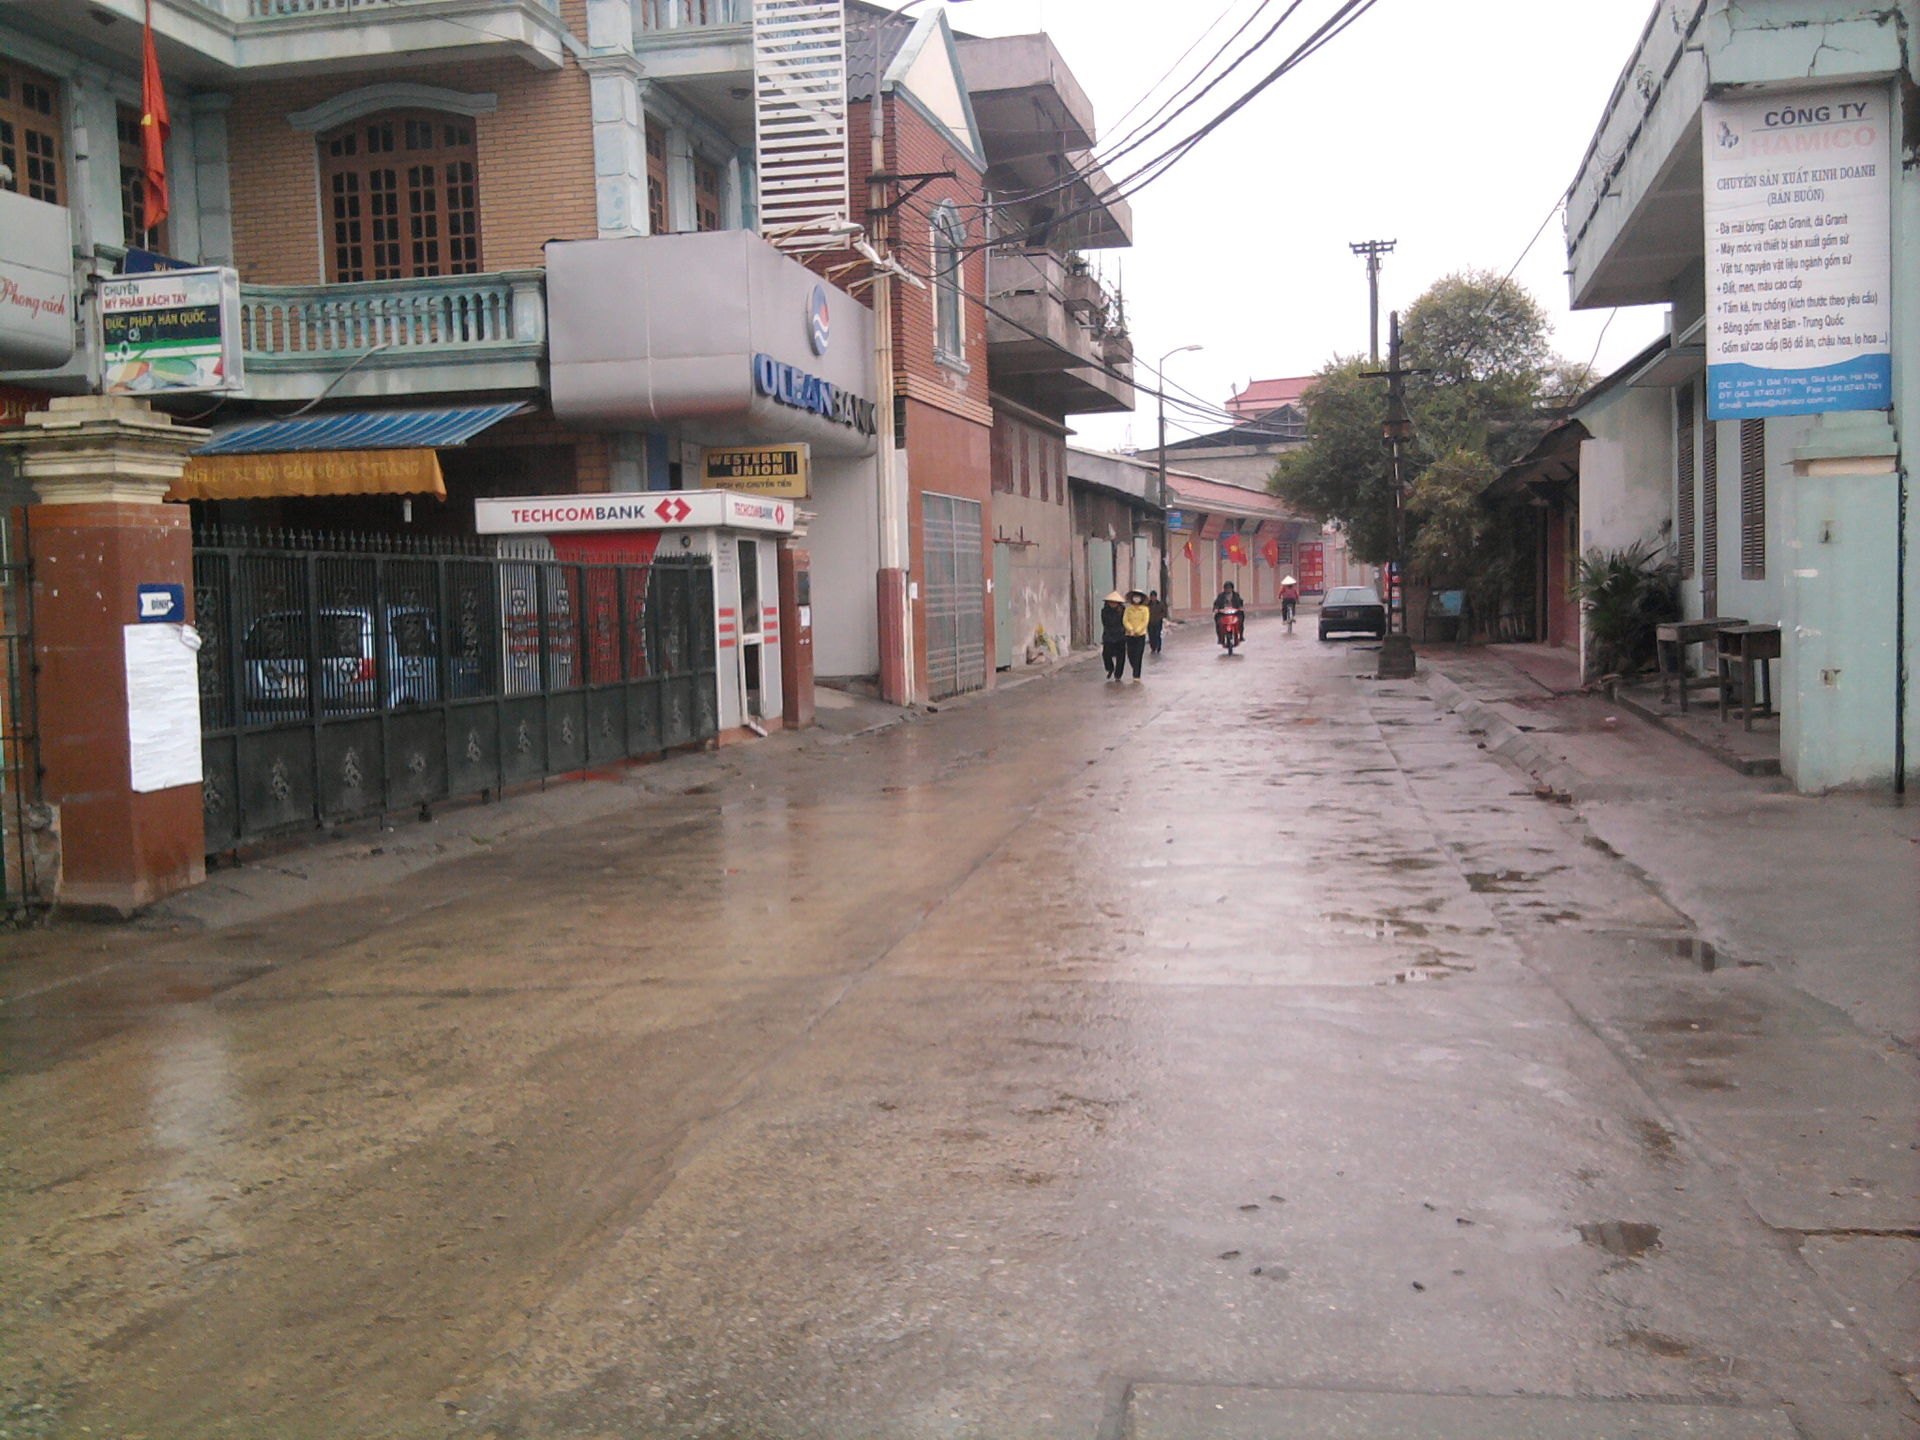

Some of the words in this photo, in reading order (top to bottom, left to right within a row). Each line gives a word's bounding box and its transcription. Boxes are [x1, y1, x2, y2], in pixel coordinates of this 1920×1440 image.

[1765, 106, 1831, 127] CÔNG
[1838, 102, 1868, 119] TY
[1752, 126, 1877, 156] HAMICO
[1811, 169, 1837, 182] KINH
[1840, 165, 1876, 180] DOANH
[1769, 219, 1787, 231] Gạch
[1825, 214, 1848, 226] Granit
[1774, 282, 1787, 291] cao
[1789, 279, 1803, 293] cấp
[42, 293, 66, 316] cách
[171, 293, 188, 304] TAY
[1829, 295, 1845, 306] theo
[1803, 315, 1823, 330] Trung
[1825, 313, 1844, 326] Quốc
[1750, 341, 1764, 351] cao
[1863, 333, 1877, 344] hoa
[754, 353, 877, 437] OCEANBANK
[709, 453, 783, 466] WESTERN
[732, 464, 783, 476] UNION
[512, 505, 646, 523] TECHCOMBANK
